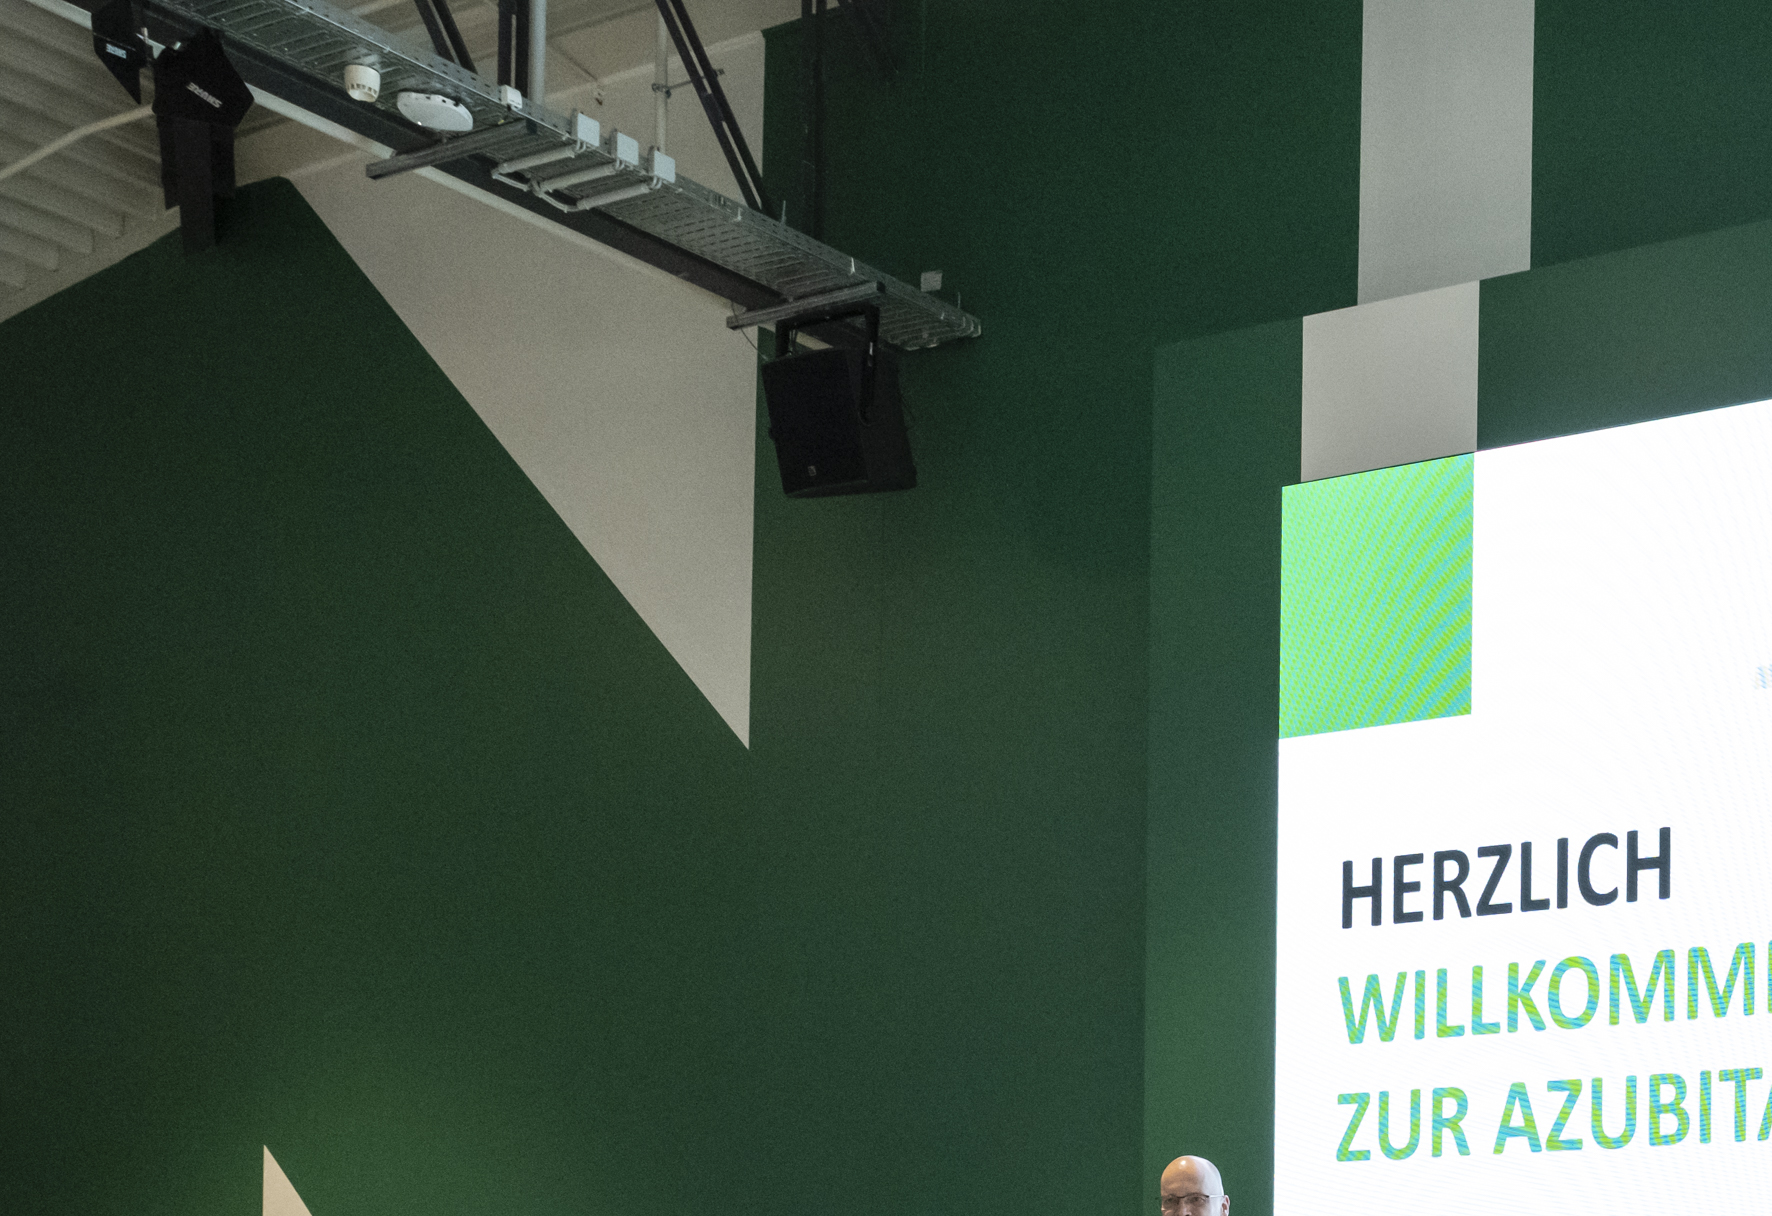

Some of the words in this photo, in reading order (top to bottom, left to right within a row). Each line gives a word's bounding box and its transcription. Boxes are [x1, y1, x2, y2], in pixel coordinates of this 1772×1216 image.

[185, 81, 223, 109] SHURE
[1341, 826, 1672, 929] HERZLICH
[1335, 1086, 1471, 1162] ZUR
